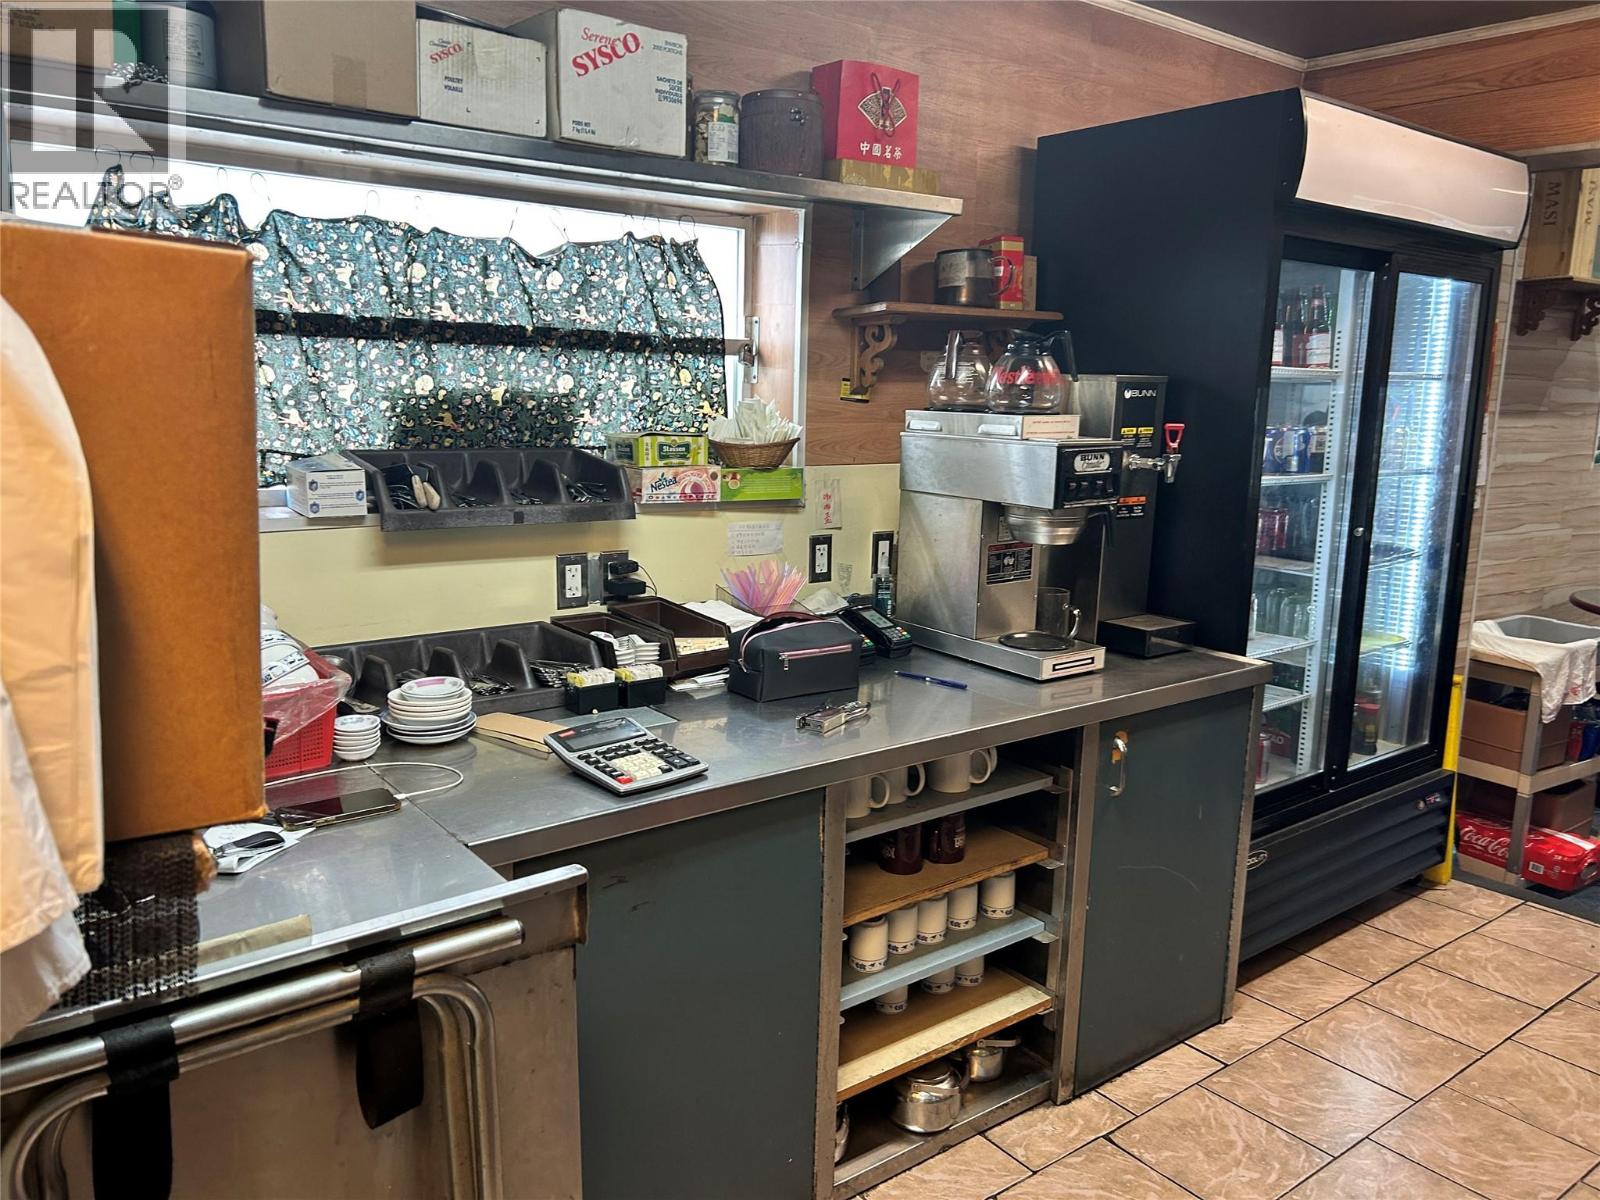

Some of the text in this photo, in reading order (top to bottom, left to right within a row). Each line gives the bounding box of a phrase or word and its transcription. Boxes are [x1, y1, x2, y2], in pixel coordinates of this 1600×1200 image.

[430, 44, 462, 64] SYSCO
[572, 32, 641, 78] SYSCO
[1543, 181, 1562, 227] MASI
[1131, 389, 1157, 398] BUNN
[1080, 453, 1105, 462] BUNN
[650, 475, 678, 493] Nestea
